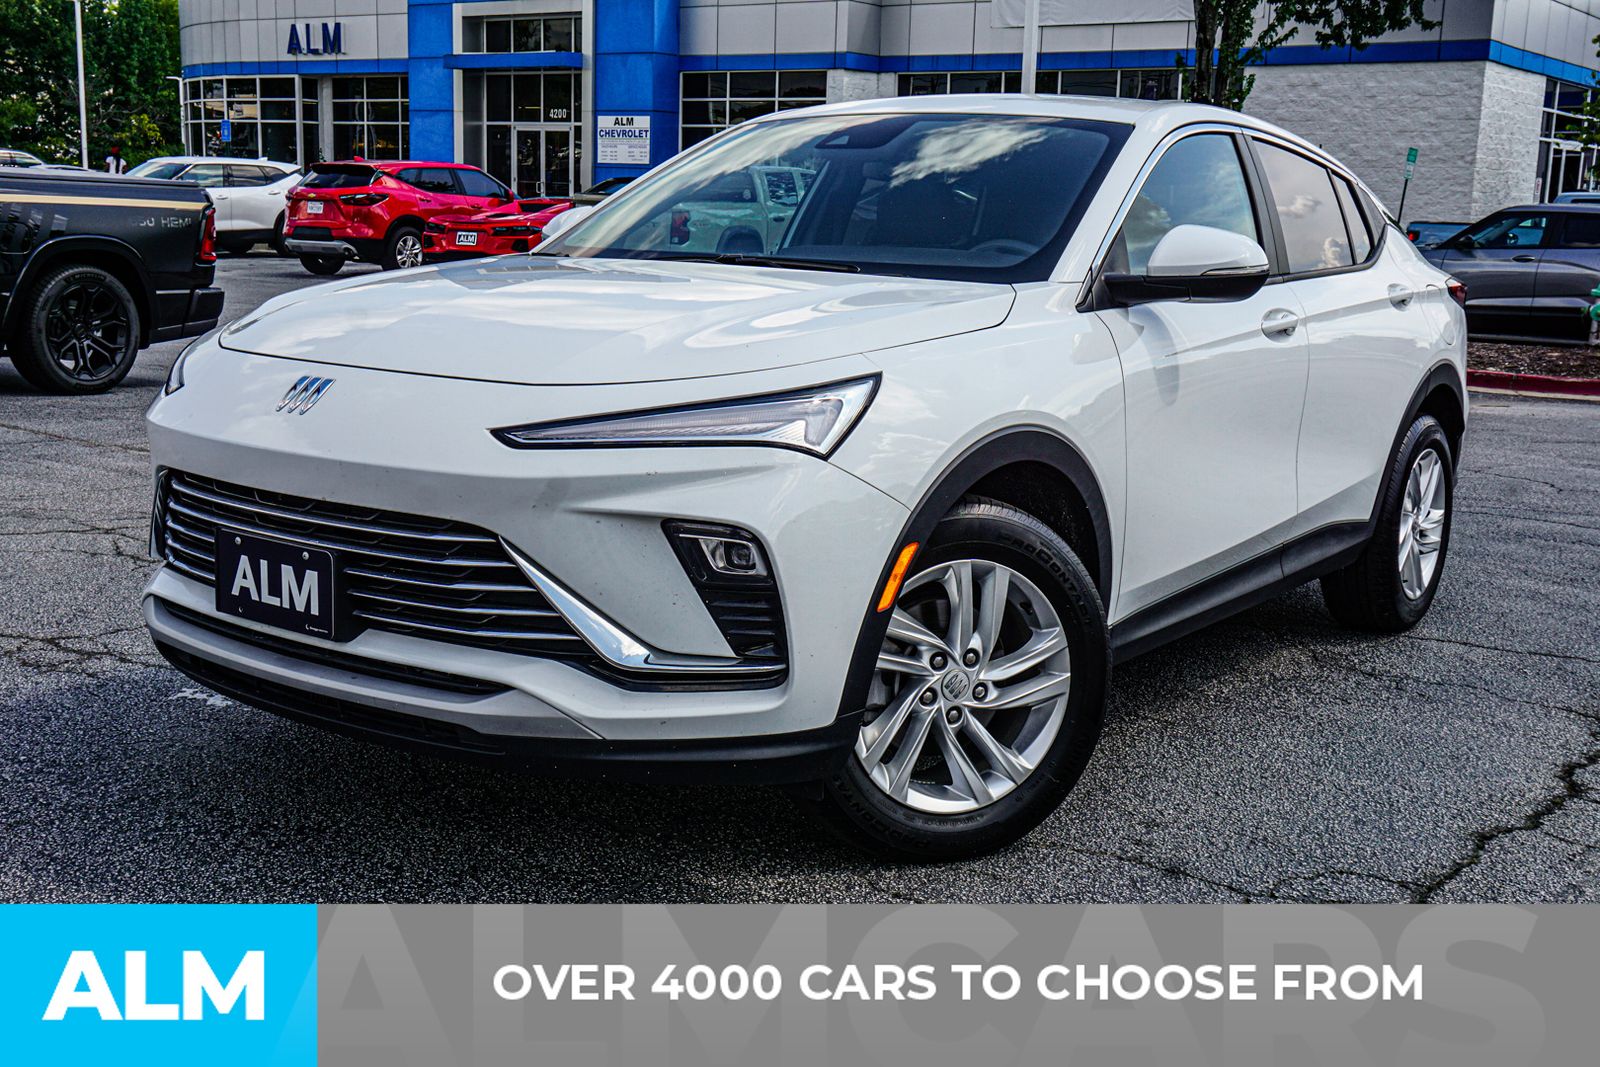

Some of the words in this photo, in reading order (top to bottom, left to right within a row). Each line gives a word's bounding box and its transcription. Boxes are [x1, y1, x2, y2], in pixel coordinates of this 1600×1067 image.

[287, 22, 342, 54] ALM
[549, 108, 567, 118] 4200
[613, 117, 634, 126] ALM
[598, 129, 649, 138] CHEVROLET
[160, 216, 192, 228] HEMI
[459, 234, 475, 242] ALM
[231, 554, 319, 616] ALM
